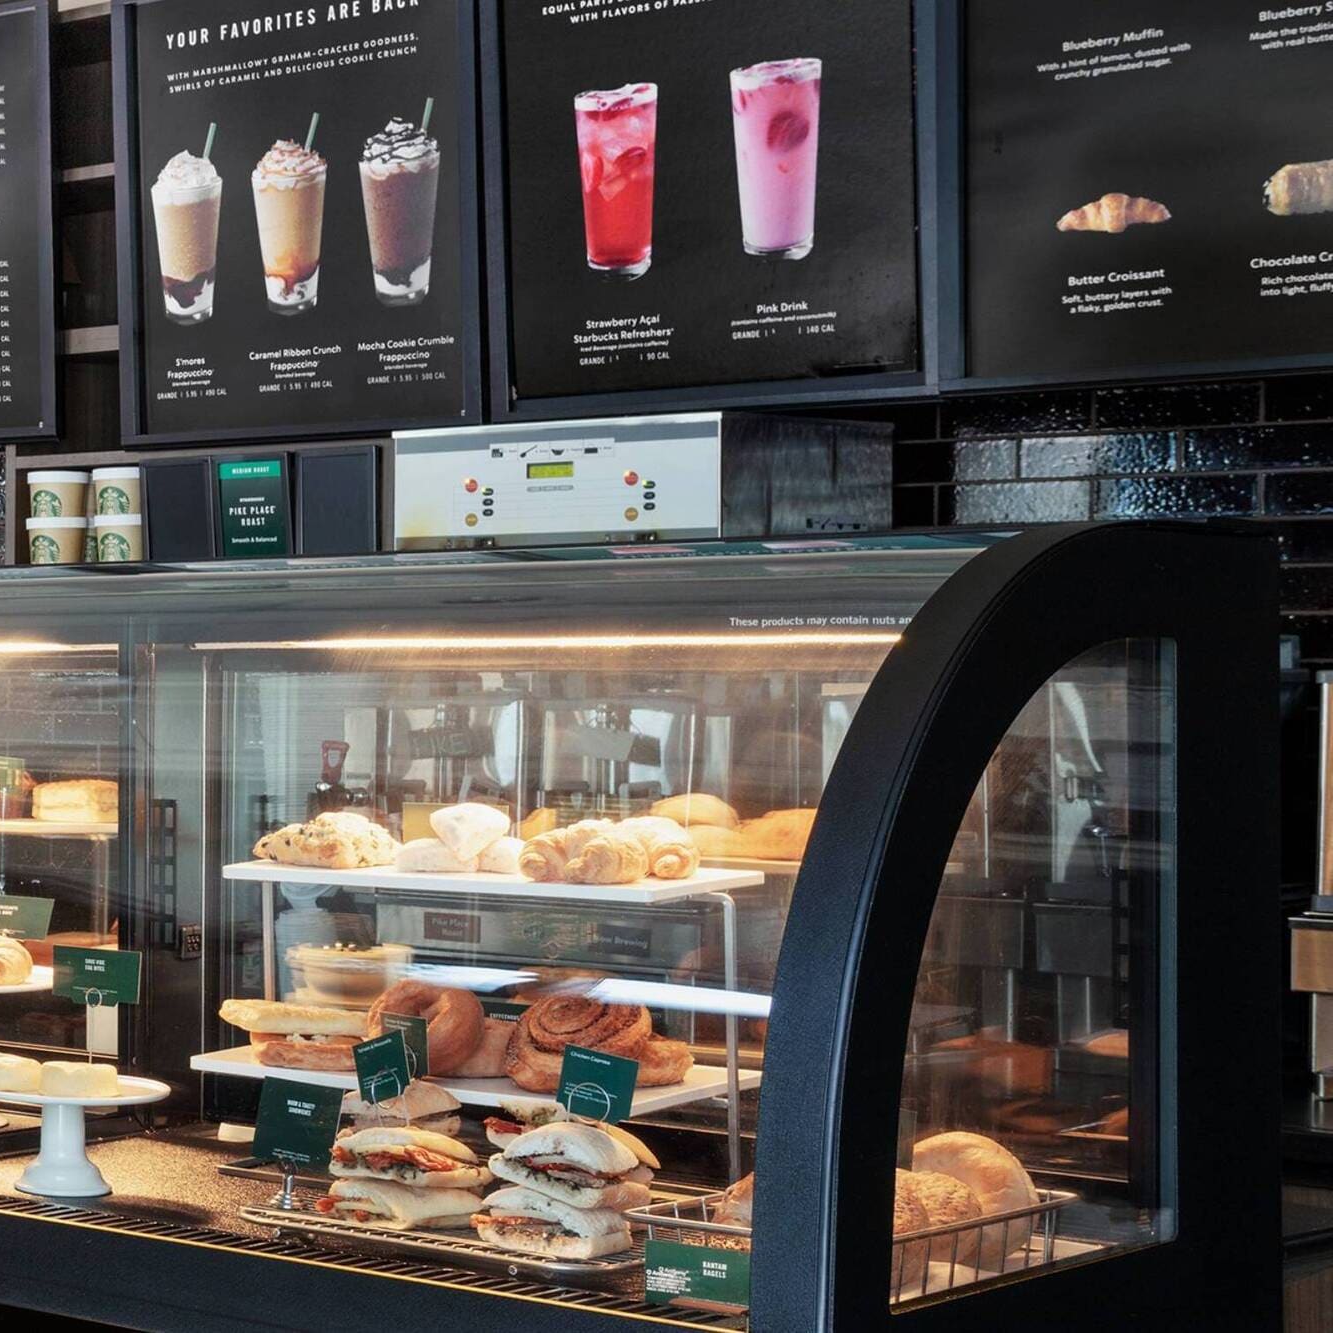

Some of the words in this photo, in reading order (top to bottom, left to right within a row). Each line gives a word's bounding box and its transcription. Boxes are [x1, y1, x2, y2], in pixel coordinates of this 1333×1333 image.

[542, 4, 575, 15] EQUAL
[570, 12, 598, 24] WITH
[603, 4, 650, 18] FLAVORS
[654, 1, 668, 9] OF
[1259, 5, 1322, 22] Blueberry
[166, 28, 209, 50] YOUR
[220, 9, 316, 40] FAVORITES
[327, 1, 360, 21] ARE
[1062, 36, 1120, 52] Blueberry
[1123, 28, 1164, 42] Muffin
[166, 71, 189, 82] WITH
[192, 58, 268, 77] MARSHMALLOWY
[271, 42, 359, 64] GRAHAM-CRACKER
[363, 32, 418, 48] GOODNESS.
[1036, 62, 1060, 72] With
[1068, 58, 1087, 67] hint
[1088, 55, 1099, 65] of
[1100, 52, 1133, 63] lemon,
[1134, 45, 1168, 58] dusted
[1169, 42, 1191, 53] with
[169, 81, 201, 94] SWIRLS
[204, 79, 215, 88] OF
[218, 72, 260, 85] CARAMEL
[264, 68, 282, 77] AND
[285, 59, 335, 74] DELICIOUS
[338, 52, 373, 65] COOKIE
[377, 46, 417, 59] CRUNCH
[1054, 69, 1091, 80] crunchy
[1092, 60, 1143, 77] granulated
[1144, 58, 1172, 68] sugar.
[1250, 254, 1317, 268] Chocolate
[1068, 275, 1105, 286] Butter
[1107, 269, 1165, 282] Croissant
[1061, 294, 1083, 304] Soft,
[1084, 293, 1120, 302] buttery
[1121, 290, 1149, 299] layers
[1150, 286, 1172, 295] with
[756, 303, 779, 314] Pink
[780, 301, 808, 312] Drink
[1077, 304, 1102, 313] flaky,
[1103, 301, 1136, 312] golden
[1137, 299, 1163, 308] crust.
[586, 318, 637, 329] Strawberry
[639, 314, 660, 326] Açaí
[573, 332, 619, 344] Starbucks
[732, 330, 760, 340] GRANDE
[806, 325, 820, 334] 140
[821, 324, 835, 332] CAL
[357, 341, 386, 351] Mocha
[386, 339, 416, 349] Cookie
[417, 335, 454, 346] Crumble
[249, 349, 282, 360] Caramel
[283, 348, 311, 357] Ribbon
[312, 344, 341, 355] Crunch
[175, 357, 205, 366] S'mores
[259, 383, 280, 392] GRANDE
[321, 380, 333, 388] CAL
[729, 617, 759, 629] These
[761, 616, 804, 629] products
[806, 617, 829, 628] may
[829, 615, 869, 625] contain
[872, 616, 896, 625] nuts
[703, 1261, 727, 1270] BANTAM
[703, 1269, 726, 1278] BAGELS
